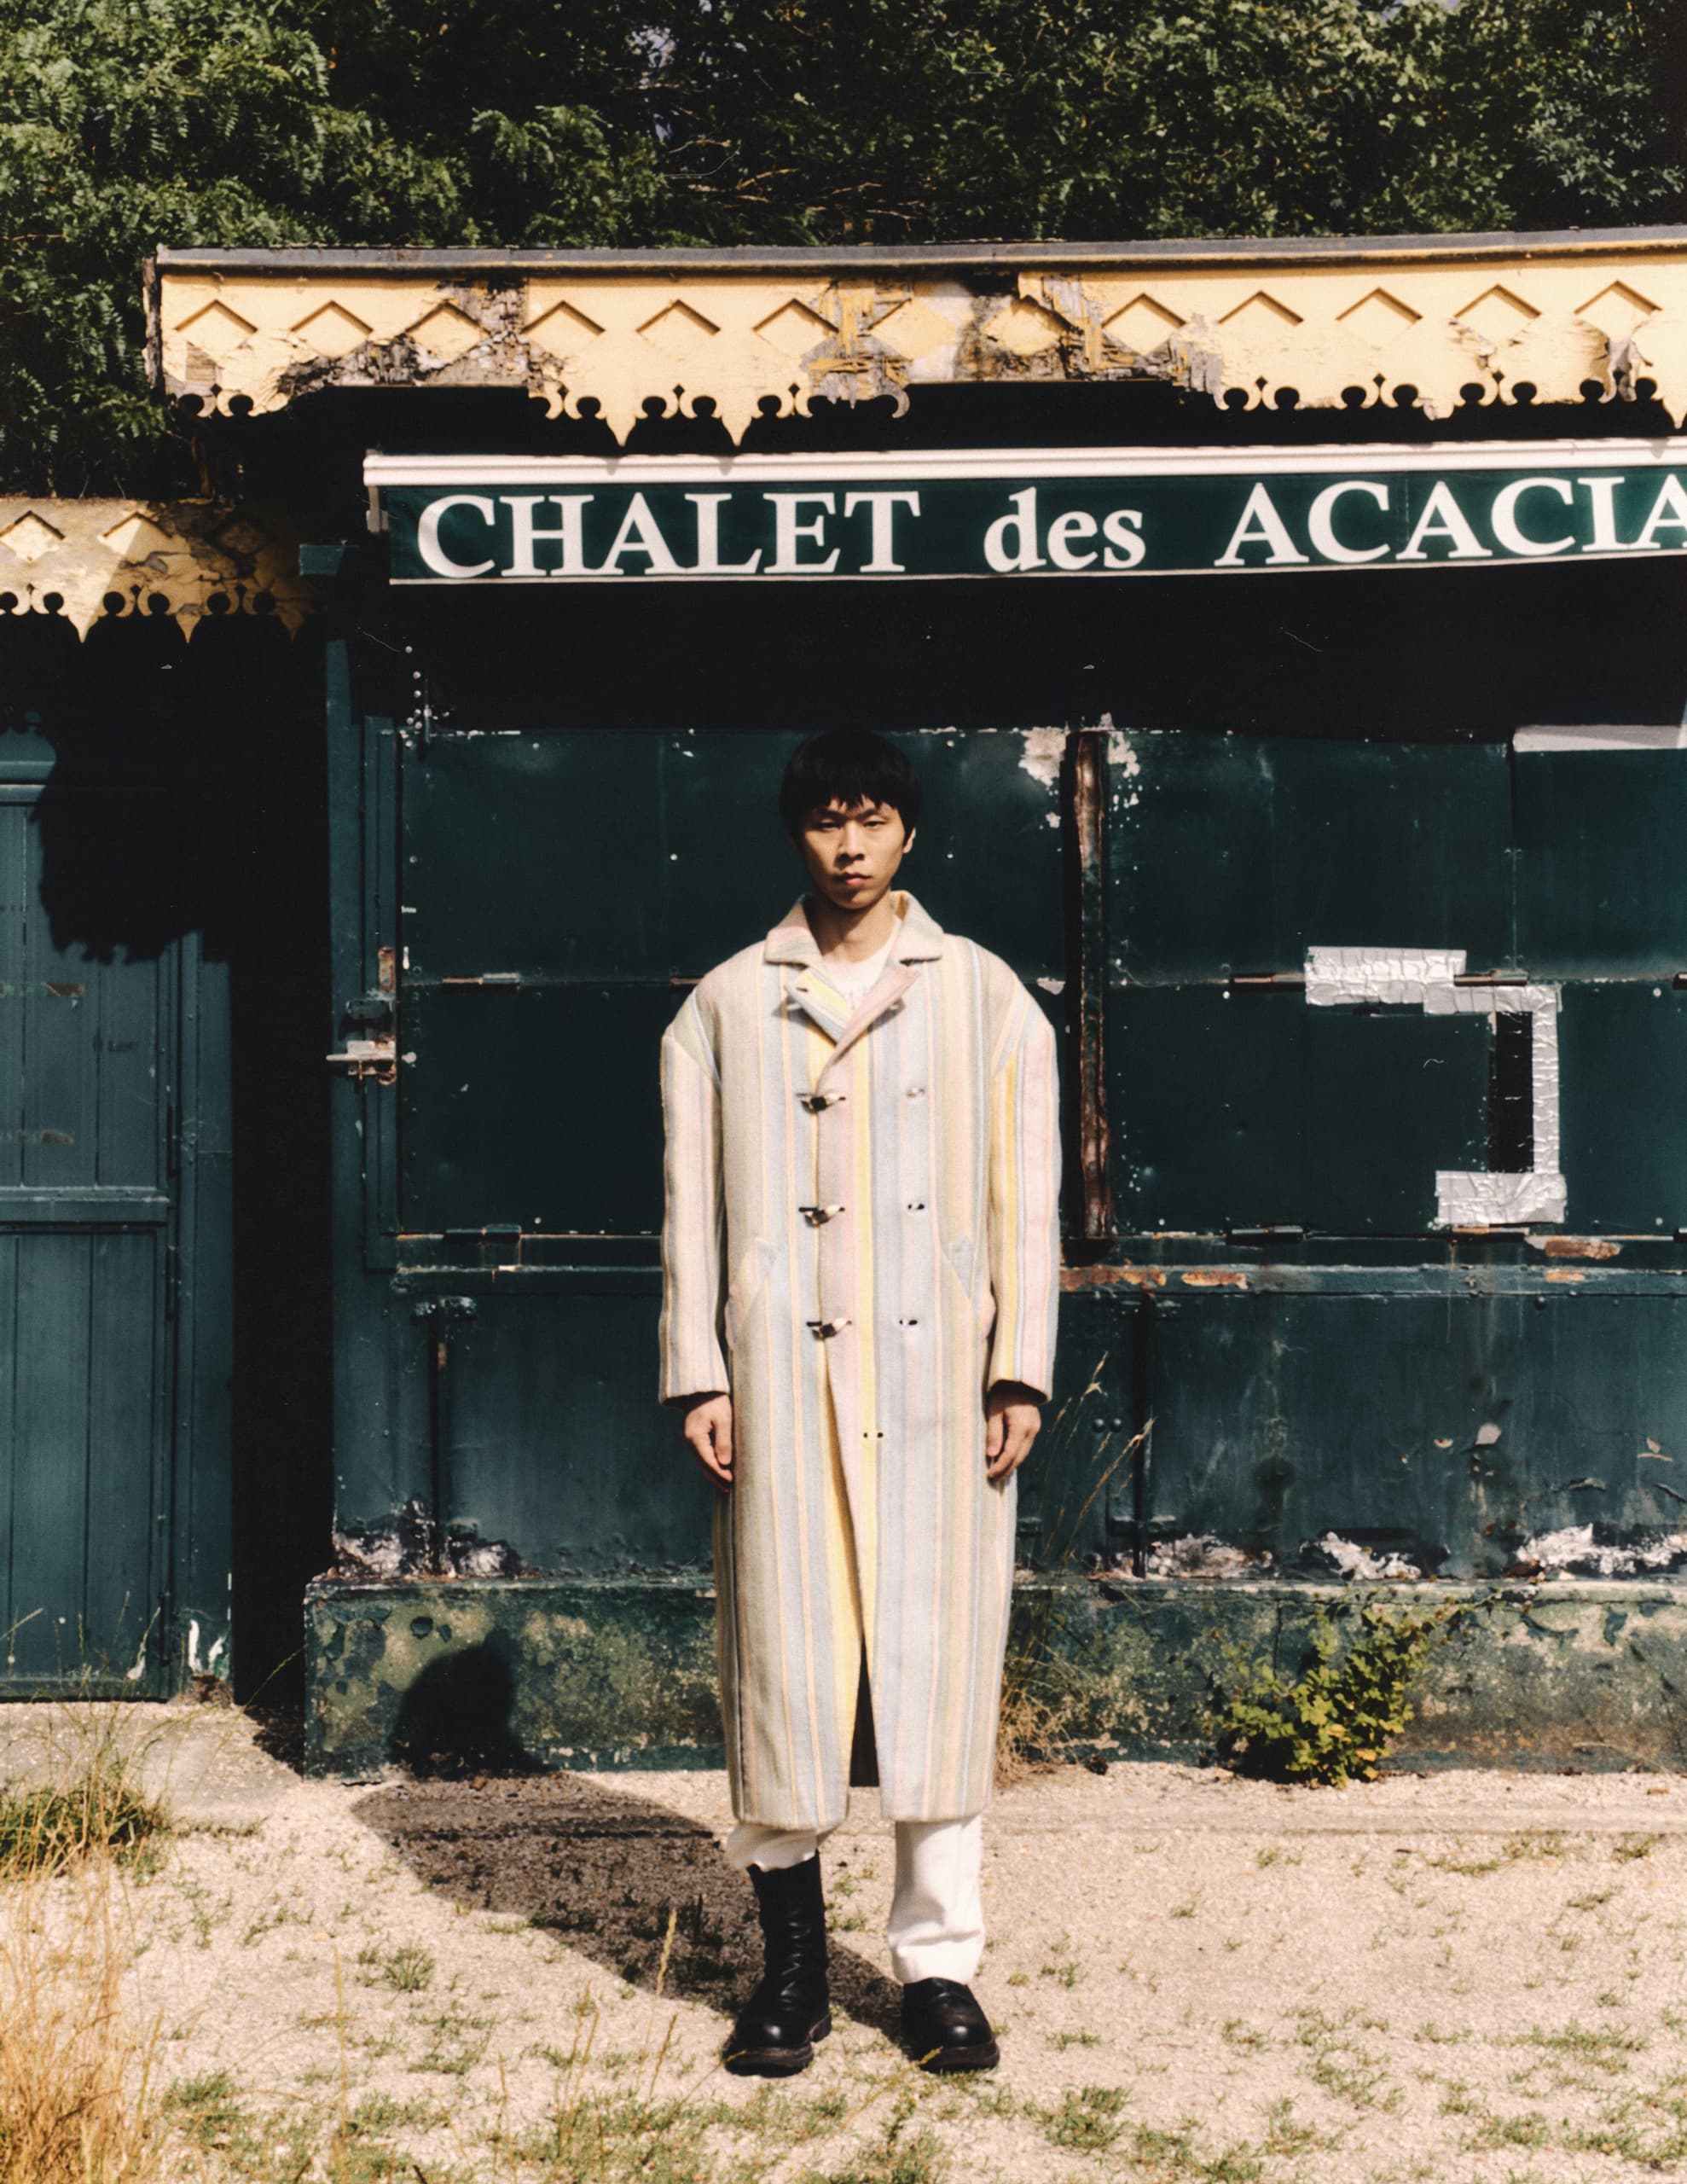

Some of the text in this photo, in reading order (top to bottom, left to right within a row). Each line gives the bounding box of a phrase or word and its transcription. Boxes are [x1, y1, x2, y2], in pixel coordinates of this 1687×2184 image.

[417, 473, 1687, 577] CHALET des ACACIA
